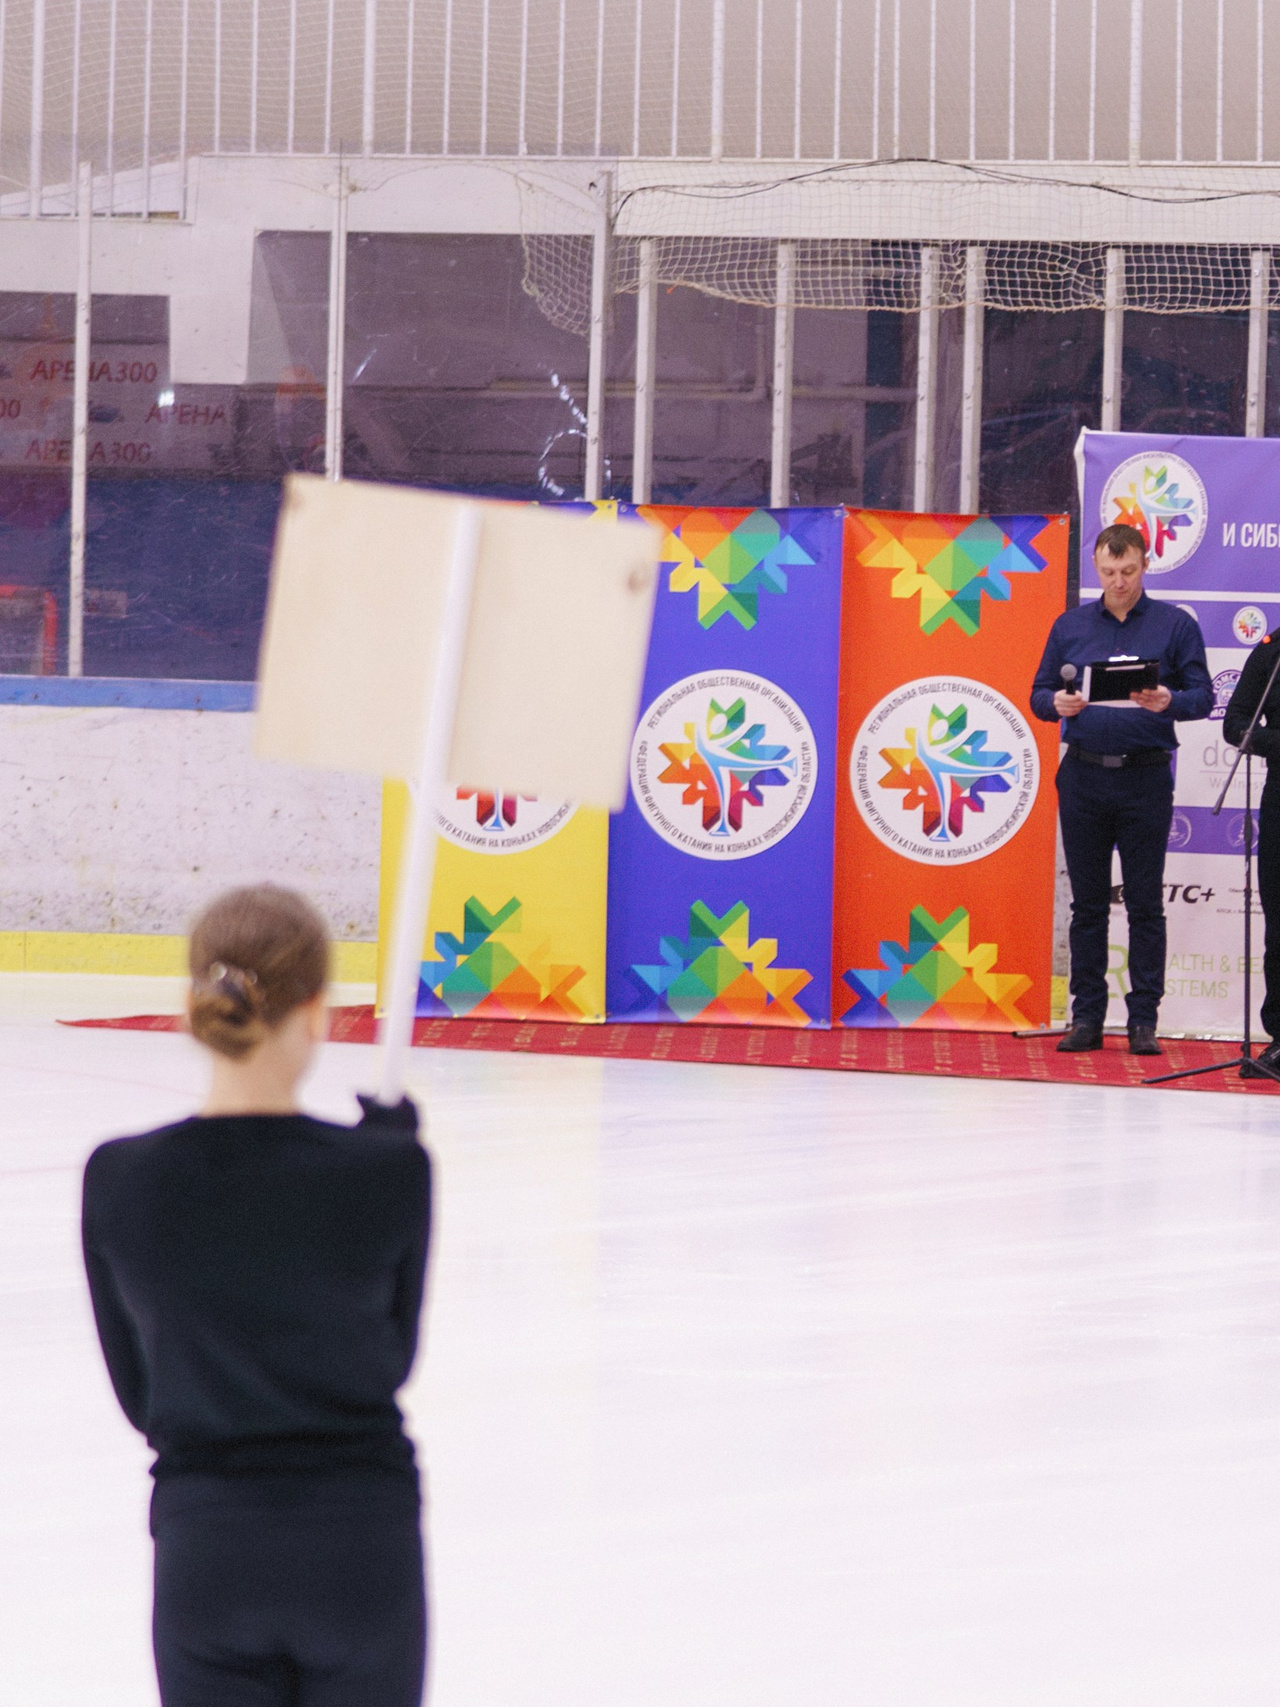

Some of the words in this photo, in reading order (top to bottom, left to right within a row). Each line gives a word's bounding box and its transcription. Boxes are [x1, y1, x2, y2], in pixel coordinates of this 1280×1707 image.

[24, 439, 152, 465] АРЕА300
[1222, 522, 1236, 547] И
[648, 683, 696, 729] РЕГИОНАЛЬНАЯ
[697, 676, 760, 693] ОБЩЕСТВЕННАЯ
[761, 687, 804, 733] ОРГАНИЗАЦИЯ
[868, 688, 917, 734] РЕГИОНАЛЬНАЯ
[918, 682, 982, 698] ОБЩЕСТВЕННАЯ
[982, 693, 1026, 740] ОРГАНИЗАЦИЯ
[644, 792, 679, 837] ФИГУРНОГО
[677, 832, 712, 852] КАТАНИЯ
[714, 843, 725, 853] НА
[727, 838, 763, 854] КОНЬКАХ
[763, 785, 807, 842] НОВОСИБИРСКОЙ
[865, 798, 899, 842] ФИГУРНОГО
[897, 837, 933, 858] КАТАНИЯ
[935, 849, 945, 858] НА
[947, 844, 984, 859] КОНЬКАХ
[985, 790, 1030, 848] НОВОСИБИРСКОЙ
[488, 838, 499, 848] НА
[1168, 953, 1215, 972] ALTH
[1219, 954, 1231, 973] &
[1164, 979, 1229, 999] STEMS
